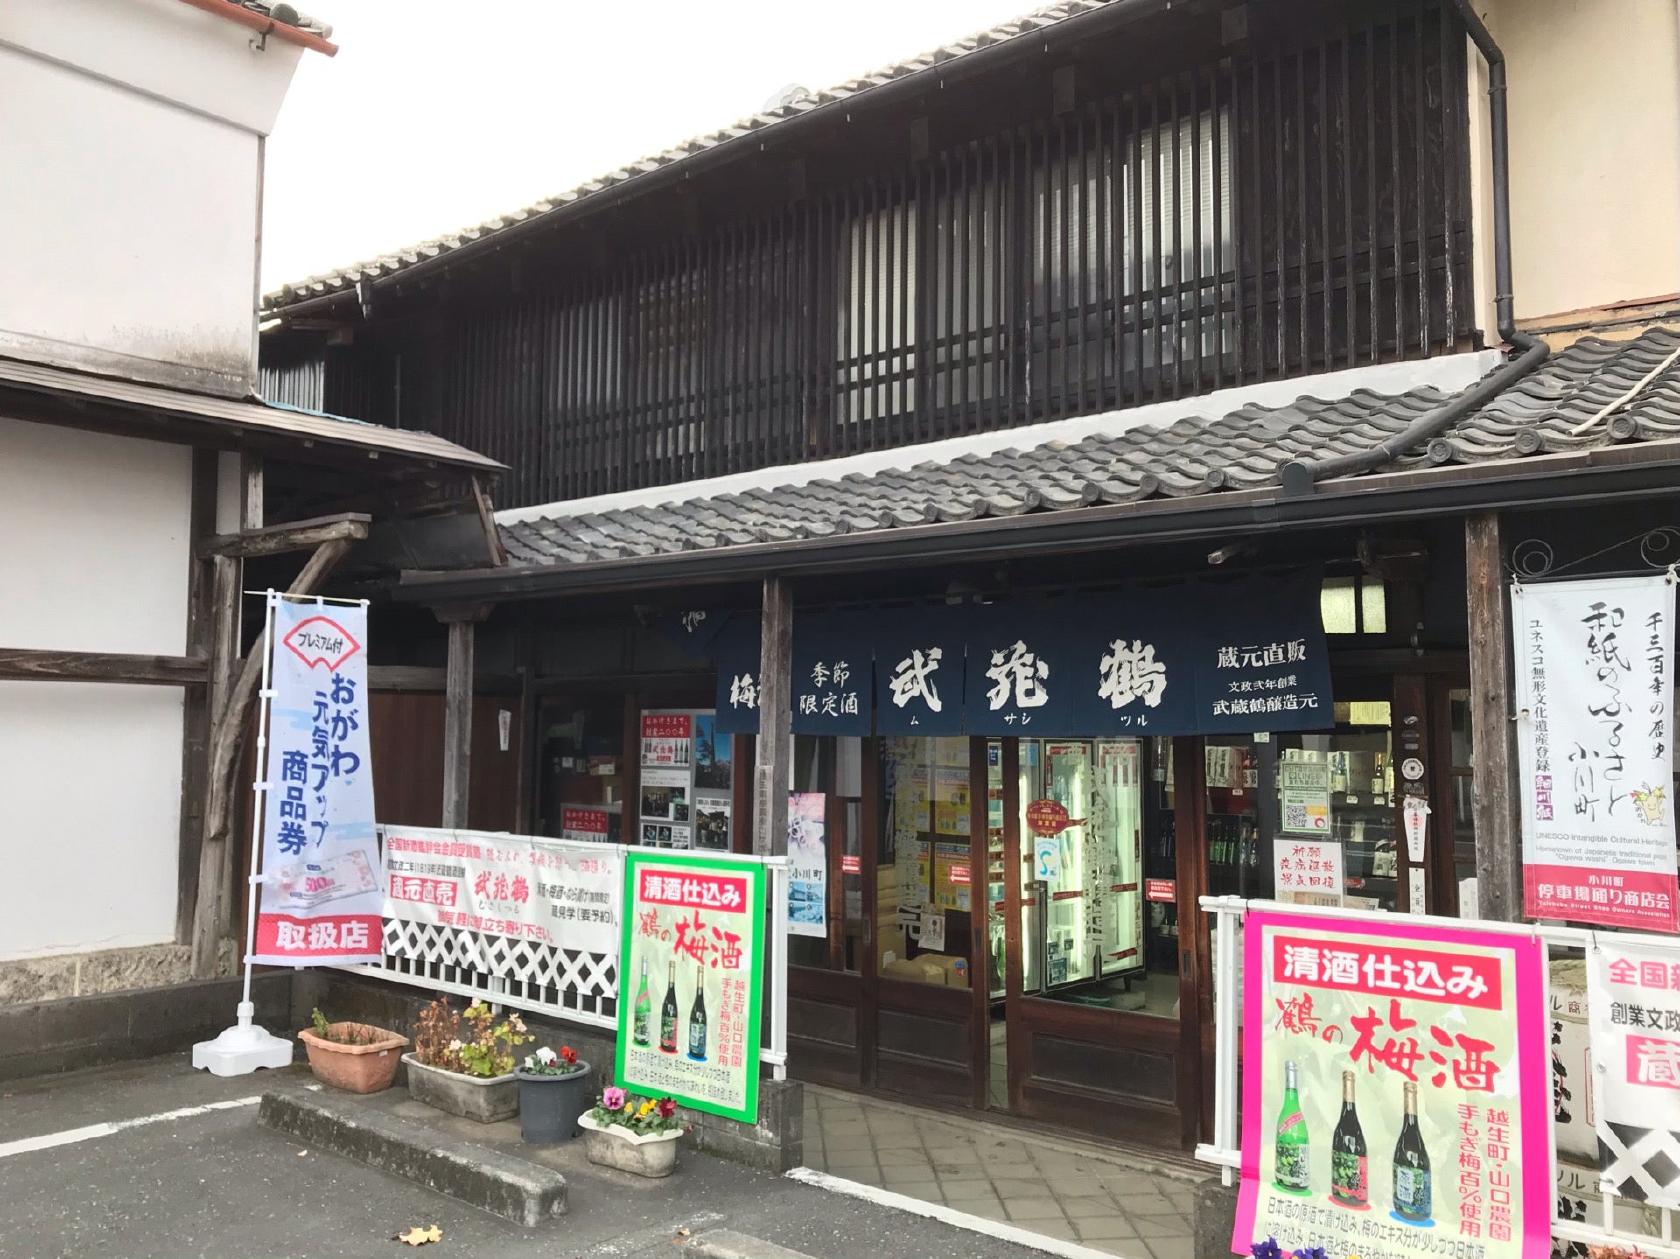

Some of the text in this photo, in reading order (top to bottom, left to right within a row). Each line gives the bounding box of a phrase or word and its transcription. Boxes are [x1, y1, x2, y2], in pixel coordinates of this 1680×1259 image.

[297, 632, 344, 654] プレミアム付
[1216, 638, 1307, 669] 蔵元直販
[728, 672, 763, 710] 梅
[810, 660, 850, 689] 季節
[799, 691, 859, 718] 限定酒
[1530, 618, 1551, 773] ユネスコ無形文化遺産登録
[1581, 601, 1632, 817] 和紙のふるさと
[330, 673, 361, 777] おがわ
[311, 690, 330, 848] 元気アップ
[1568, 741, 1600, 822] 小川町
[278, 750, 308, 856] 商品券
[1571, 833, 1608, 843] Intangible
[1610, 835, 1640, 845] Cultural
[392, 876, 455, 906] 蔵元直売
[643, 874, 742, 908] 清酒仕込み
[791, 867, 822, 881] 小川町
[1588, 875, 1624, 887] 小川町
[1537, 884, 1670, 910] 停車場通り商店会
[275, 920, 369, 961] 取扱店
[1283, 944, 1489, 1000] 清酒仕込み
[1486, 1106, 1512, 1242] 越生町・山口農園
